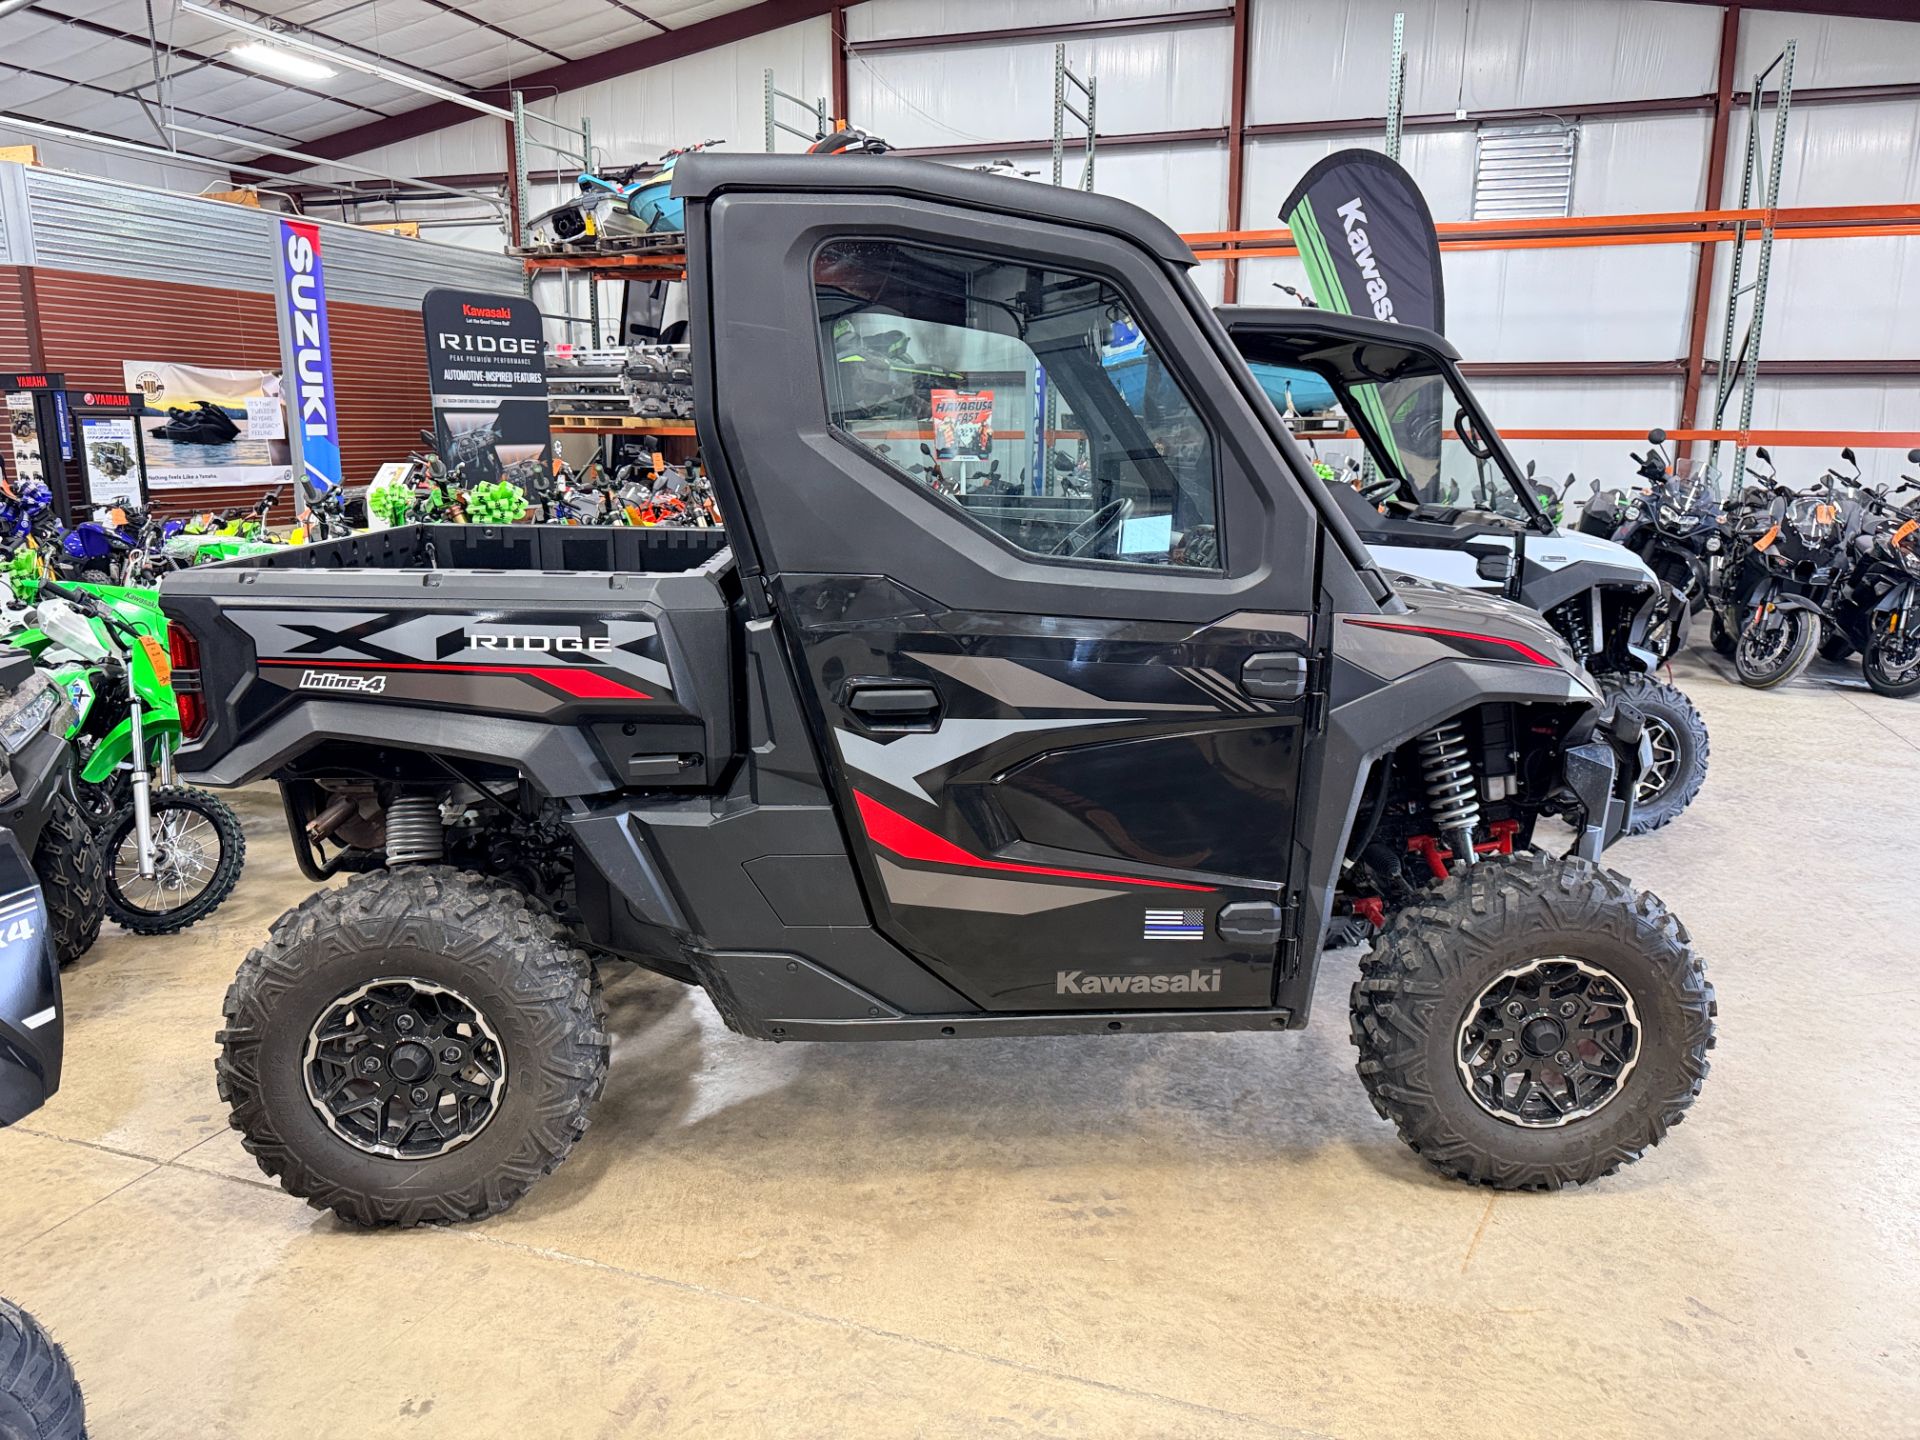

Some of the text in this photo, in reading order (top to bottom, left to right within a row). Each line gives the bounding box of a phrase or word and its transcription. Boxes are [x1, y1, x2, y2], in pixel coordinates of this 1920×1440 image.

[1336, 197, 1399, 323] Kawas
[462, 304, 511, 319] Kawasaki
[287, 234, 329, 437] SUZUKI
[439, 333, 538, 354] RIDGE
[449, 354, 531, 365] PEAK PREMIUM PERFORMANCE
[16, 375, 48, 387] YAMAHA
[443, 369, 543, 384] AUTOMOTIVE-INSPIRED FEATURES
[94, 394, 131, 406] YAMAHA
[935, 400, 993, 413] HAYABUSA
[956, 411, 980, 423] FAST
[124, 592, 158, 609] Kawasaki
[470, 634, 612, 653] RIDGE
[299, 669, 387, 694] Inline-4
[1056, 968, 1222, 995] Kawasaki
